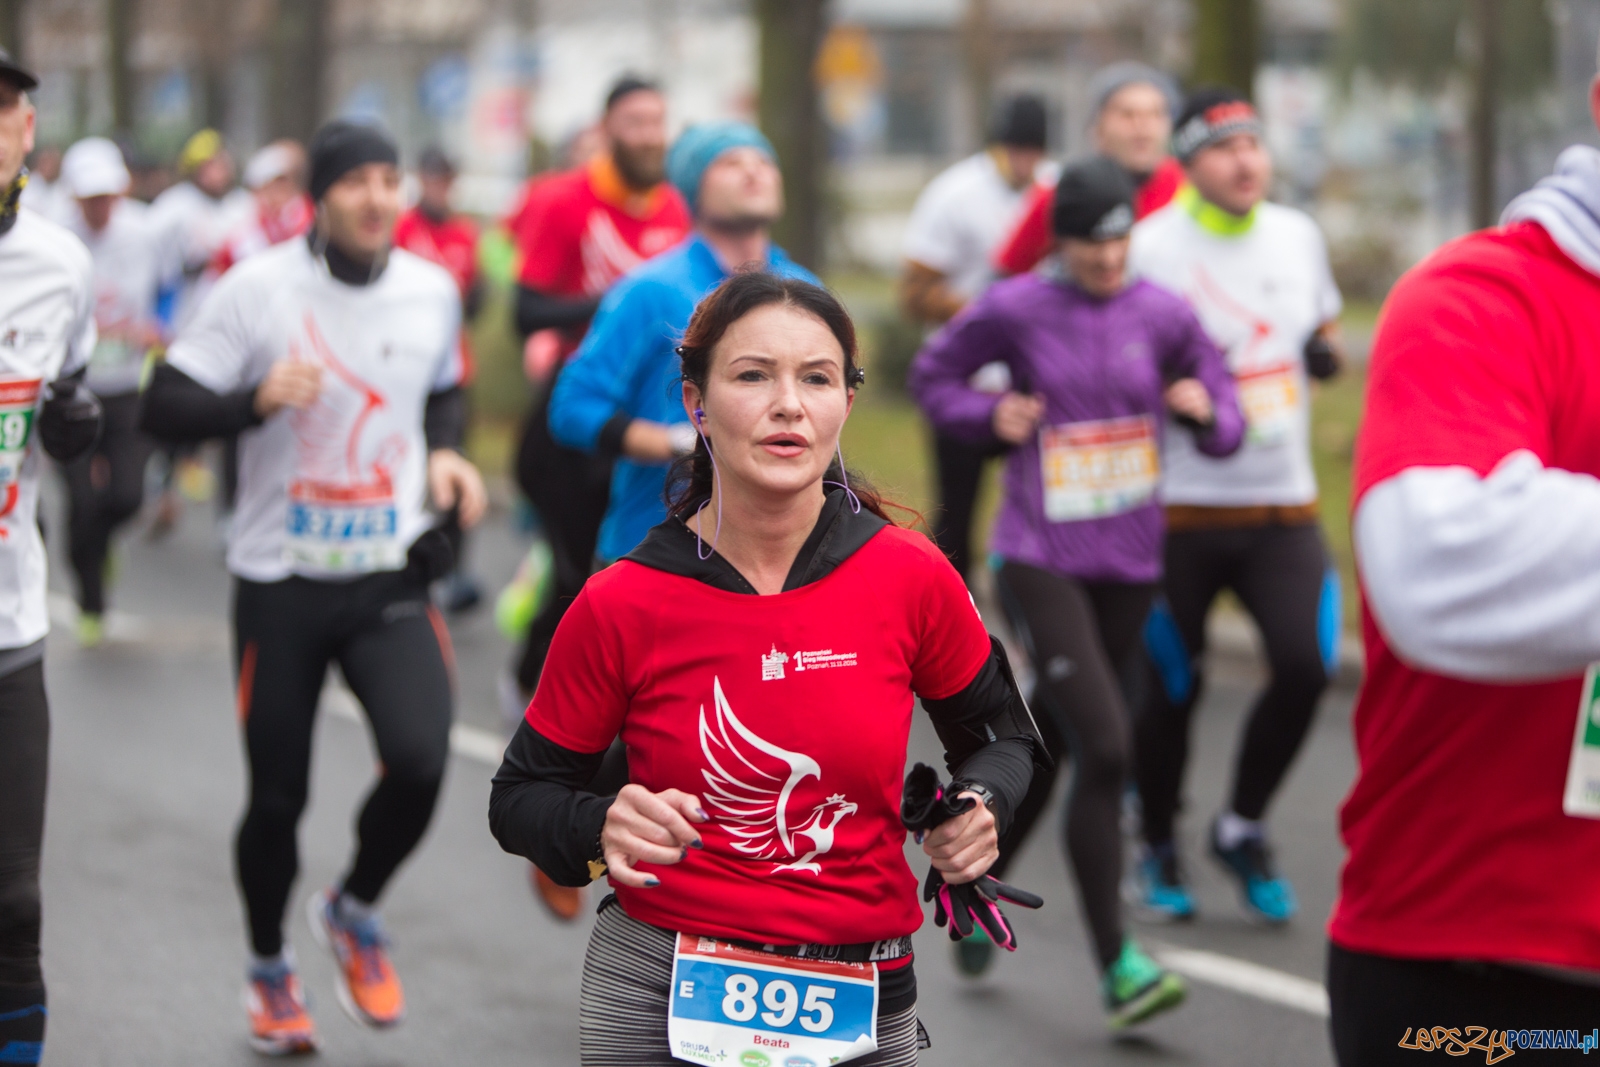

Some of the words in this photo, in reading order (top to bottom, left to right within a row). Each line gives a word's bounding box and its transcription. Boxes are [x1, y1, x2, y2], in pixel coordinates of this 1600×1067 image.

[793, 651, 806, 671] 1
[679, 981, 695, 998] E
[721, 973, 836, 1033] 895
[680, 1040, 710, 1054] GRUPA
[753, 1035, 790, 1049] Beata
